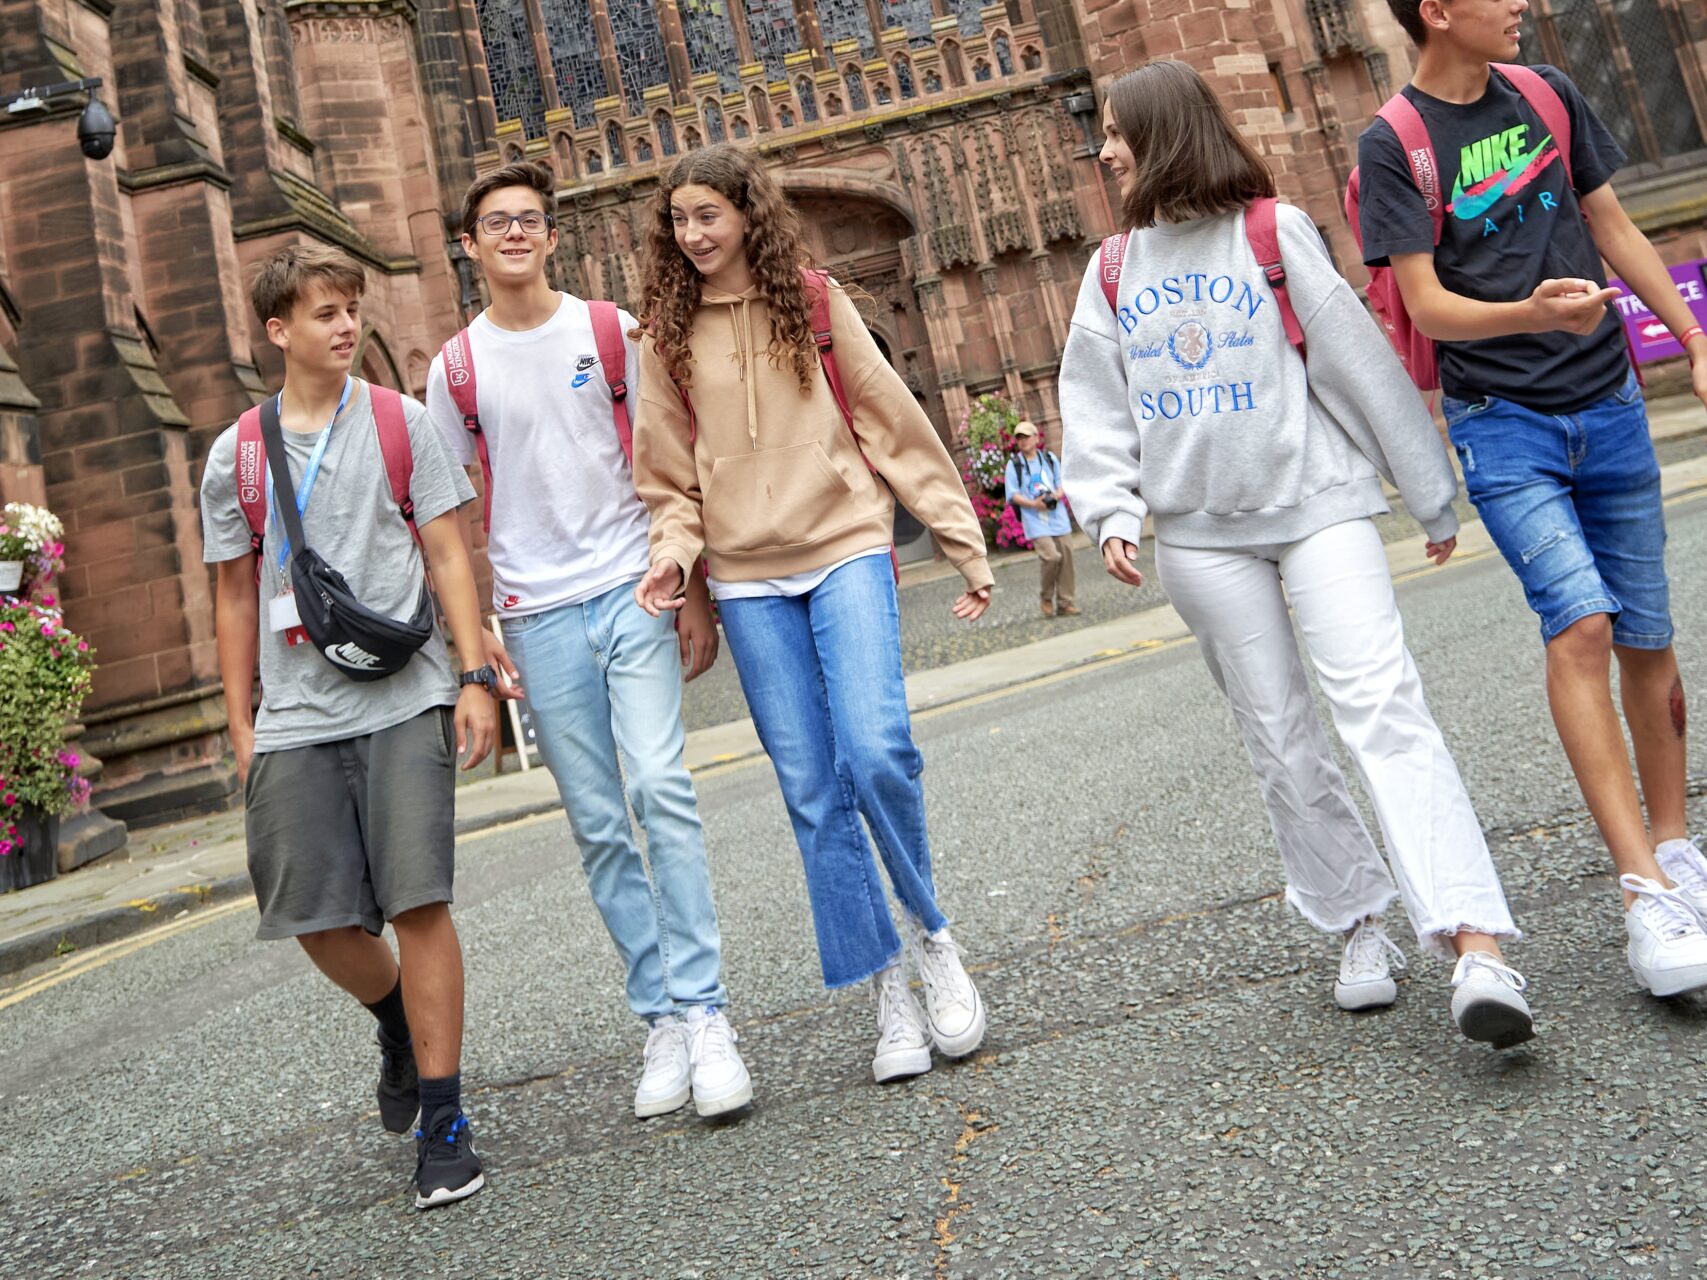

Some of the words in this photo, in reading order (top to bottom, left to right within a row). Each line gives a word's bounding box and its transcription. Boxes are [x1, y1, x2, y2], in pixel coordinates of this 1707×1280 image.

[1417, 148, 1434, 193] KINGDOM
[1460, 123, 1530, 187] NIKE
[1482, 191, 1559, 238] AIR
[1117, 273, 1267, 336] BOSTON
[1614, 280, 1704, 317] TRCE
[1216, 329, 1255, 349] States
[1140, 381, 1258, 420] SOUTH
[240, 440, 249, 486] LANGUAGE
[247, 440, 257, 486] KINGDOM
[337, 641, 381, 666] NIKE
